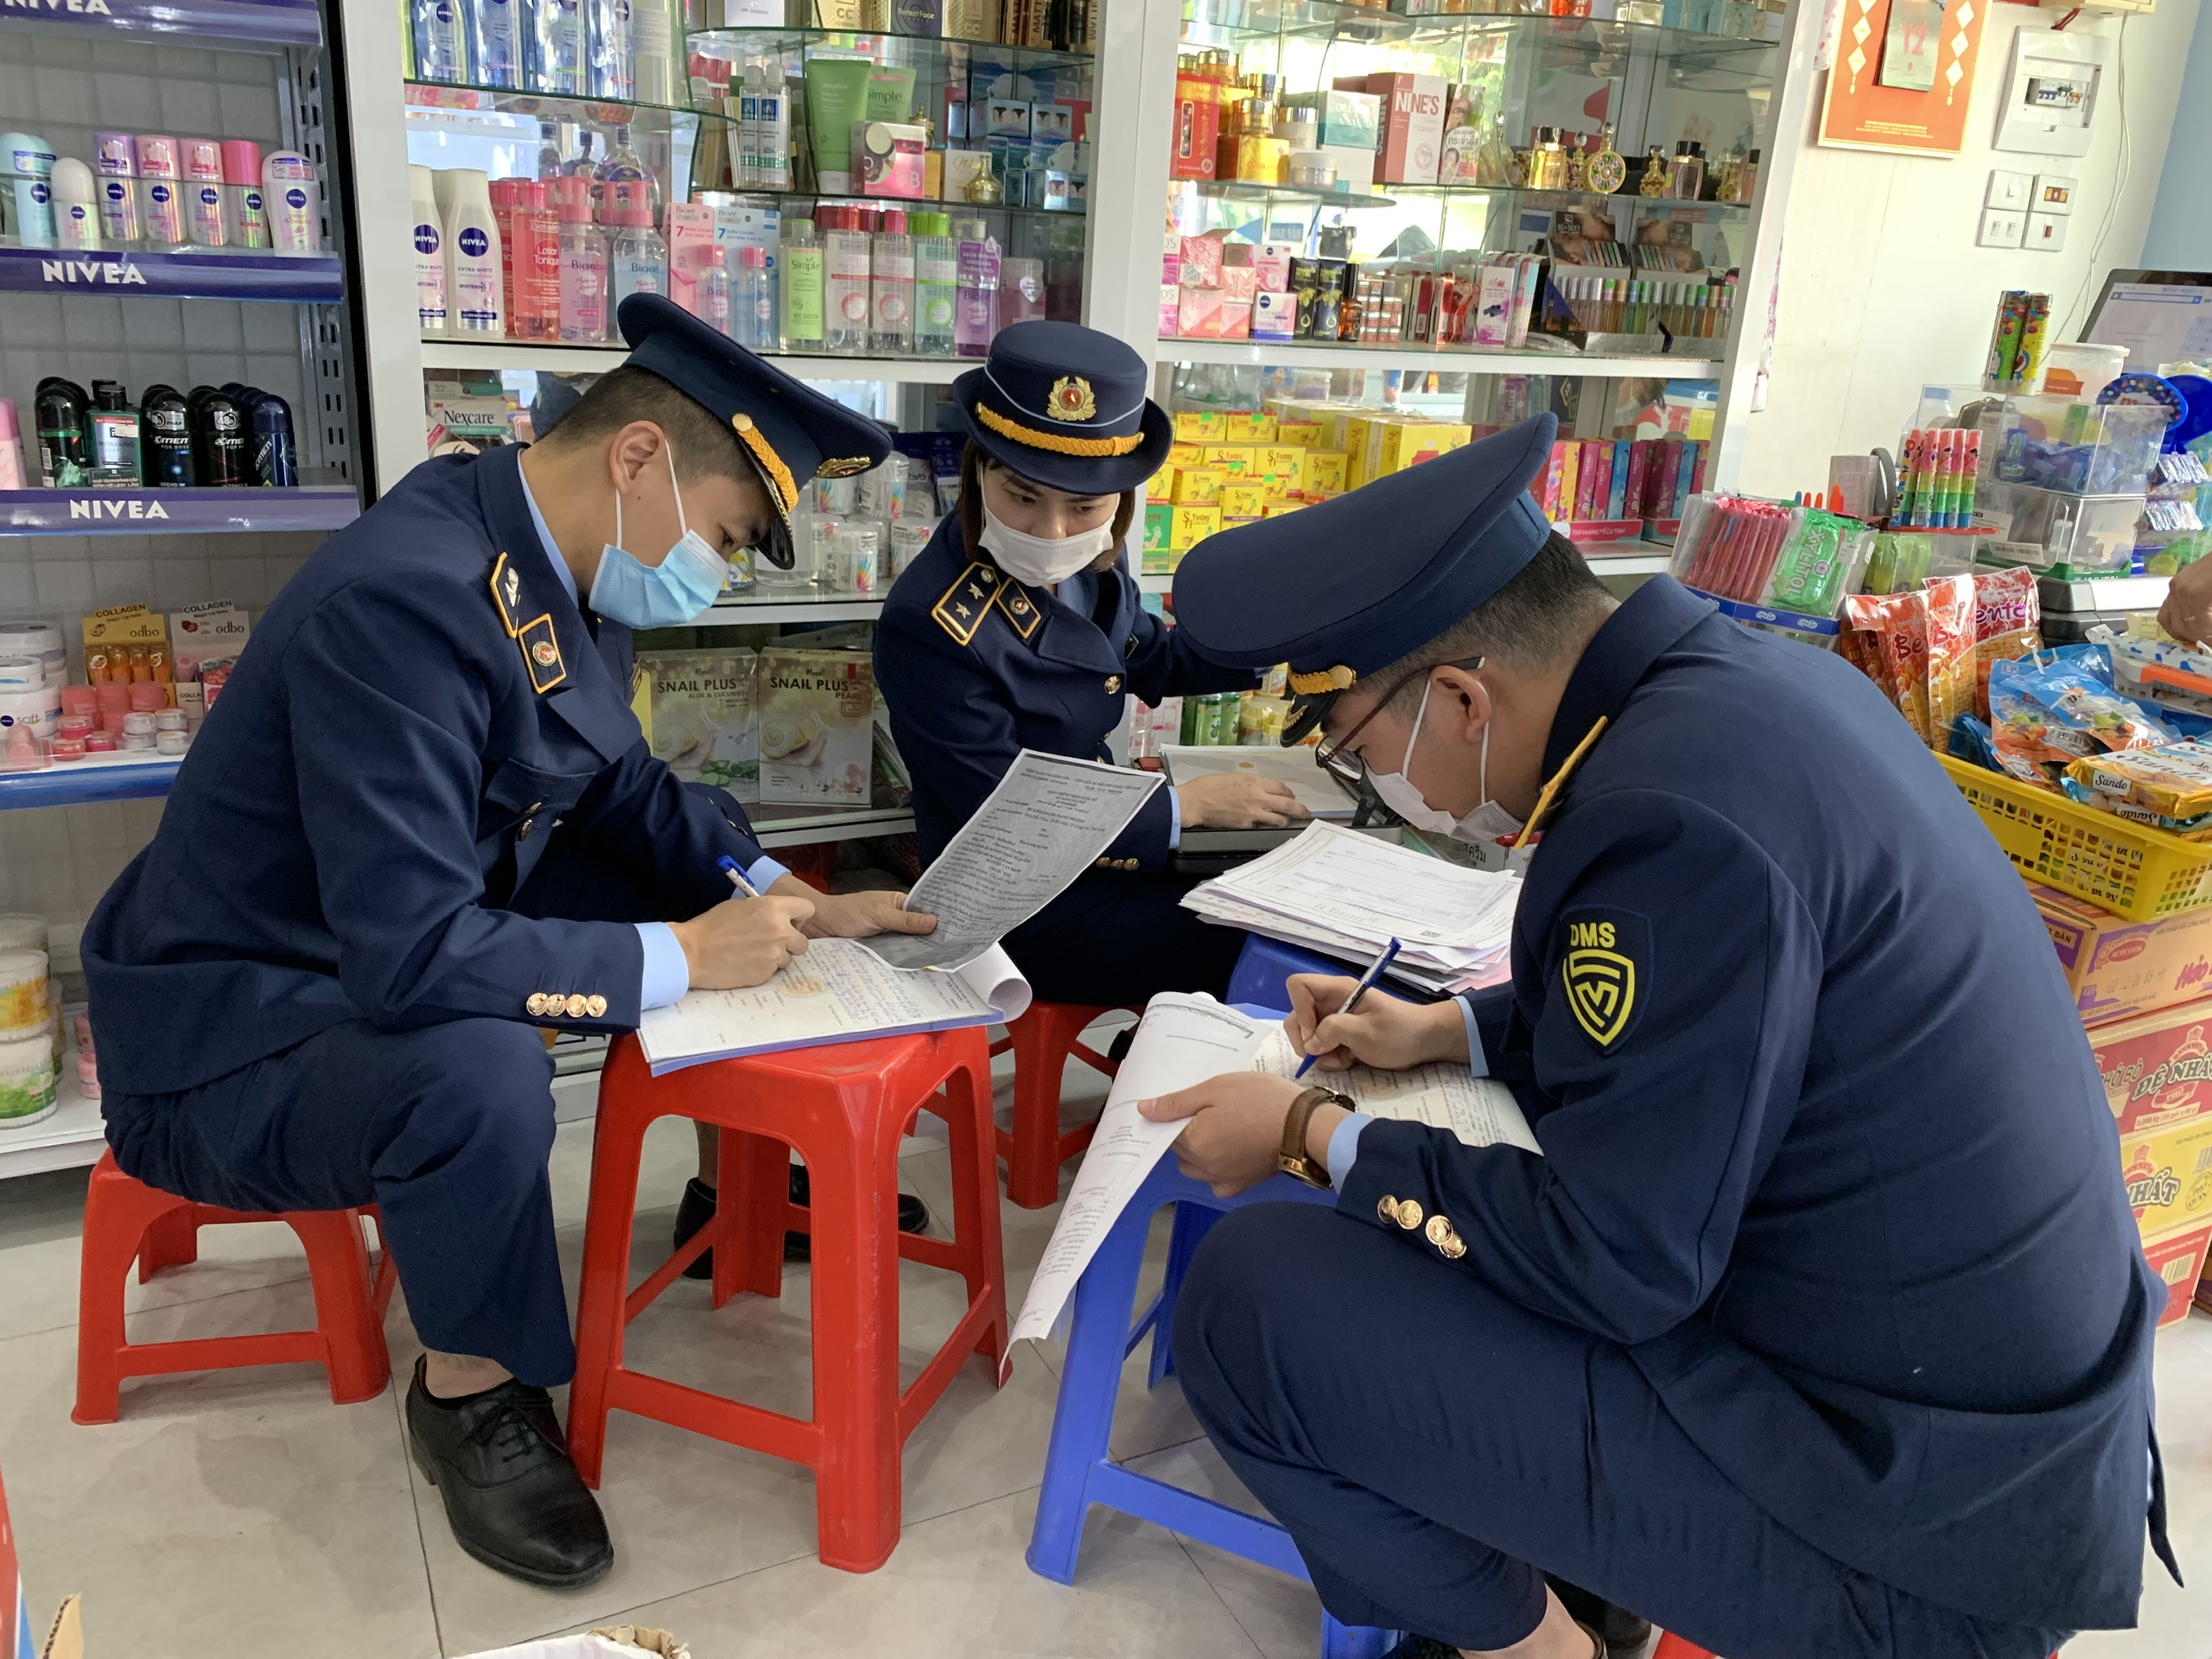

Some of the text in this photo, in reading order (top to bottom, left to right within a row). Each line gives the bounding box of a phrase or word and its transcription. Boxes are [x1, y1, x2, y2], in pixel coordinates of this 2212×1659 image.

[1902, 23, 1928, 56] 12
[1395, 91, 1440, 116] NINE'S
[676, 226, 684, 237] 7
[718, 228, 726, 239] 7
[415, 235, 437, 244] NIVEA
[461, 238, 486, 246] NIVEA
[537, 246, 559, 256] Lotion
[41, 260, 148, 285] NIVEA
[791, 258, 821, 273] Simple
[434, 385, 446, 393] 32
[444, 410, 494, 427] Nexcare
[1226, 452, 1243, 461] Today
[1276, 452, 1294, 462] Today
[1322, 460, 1338, 469] Today
[70, 499, 169, 520] NIVEA
[1192, 512, 1210, 522] Today
[1784, 528, 1827, 596] XYLITOL
[96, 604, 146, 619] COLLAGEN
[183, 600, 232, 613] COLLAGEN
[1976, 601, 2027, 625] ento
[130, 624, 160, 638] odbo
[215, 620, 245, 633] odbo
[658, 677, 737, 694] SNAIL PLUS
[770, 677, 849, 692] SNAIL PLUS
[688, 691, 706, 700] ALOE
[835, 691, 862, 701] PEARL
[16, 713, 39, 725] soft
[2094, 774, 2128, 791] Sando
[2120, 809, 2158, 824] Sando
[1570, 921, 1616, 949] DMS
[2054, 930, 2073, 944] BẢN
[2121, 1058, 2144, 1084] BÒ
[2132, 1063, 2169, 1101] ĐỆ
